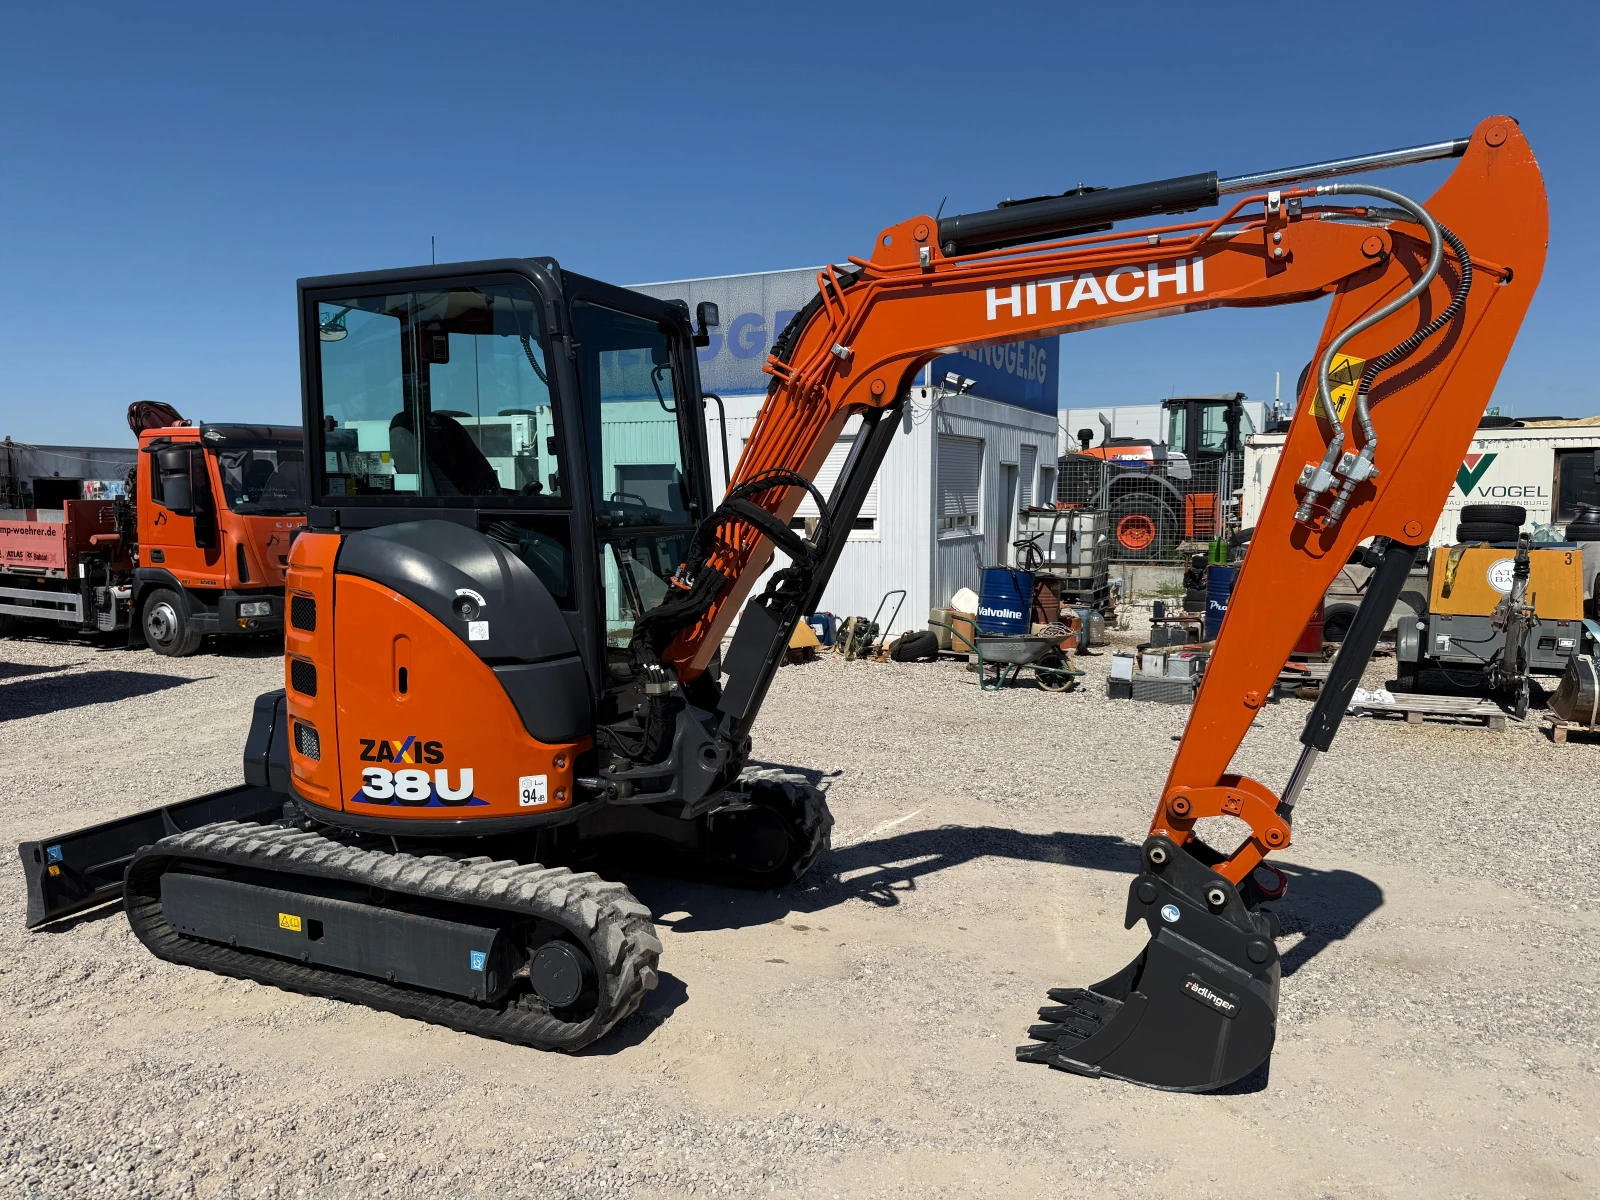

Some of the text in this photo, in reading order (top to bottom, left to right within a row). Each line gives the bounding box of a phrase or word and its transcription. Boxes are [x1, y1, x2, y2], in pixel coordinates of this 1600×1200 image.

[986, 256, 1205, 321] HITACHI
[1478, 486, 1549, 498] VOGEL
[1564, 552, 1573, 566] 3
[979, 606, 1023, 620] Valvoline
[359, 736, 445, 765] ZAXIS
[361, 767, 475, 807] 38U
[522, 788, 537, 804] 94
[1185, 981, 1235, 1010] rädlinger
